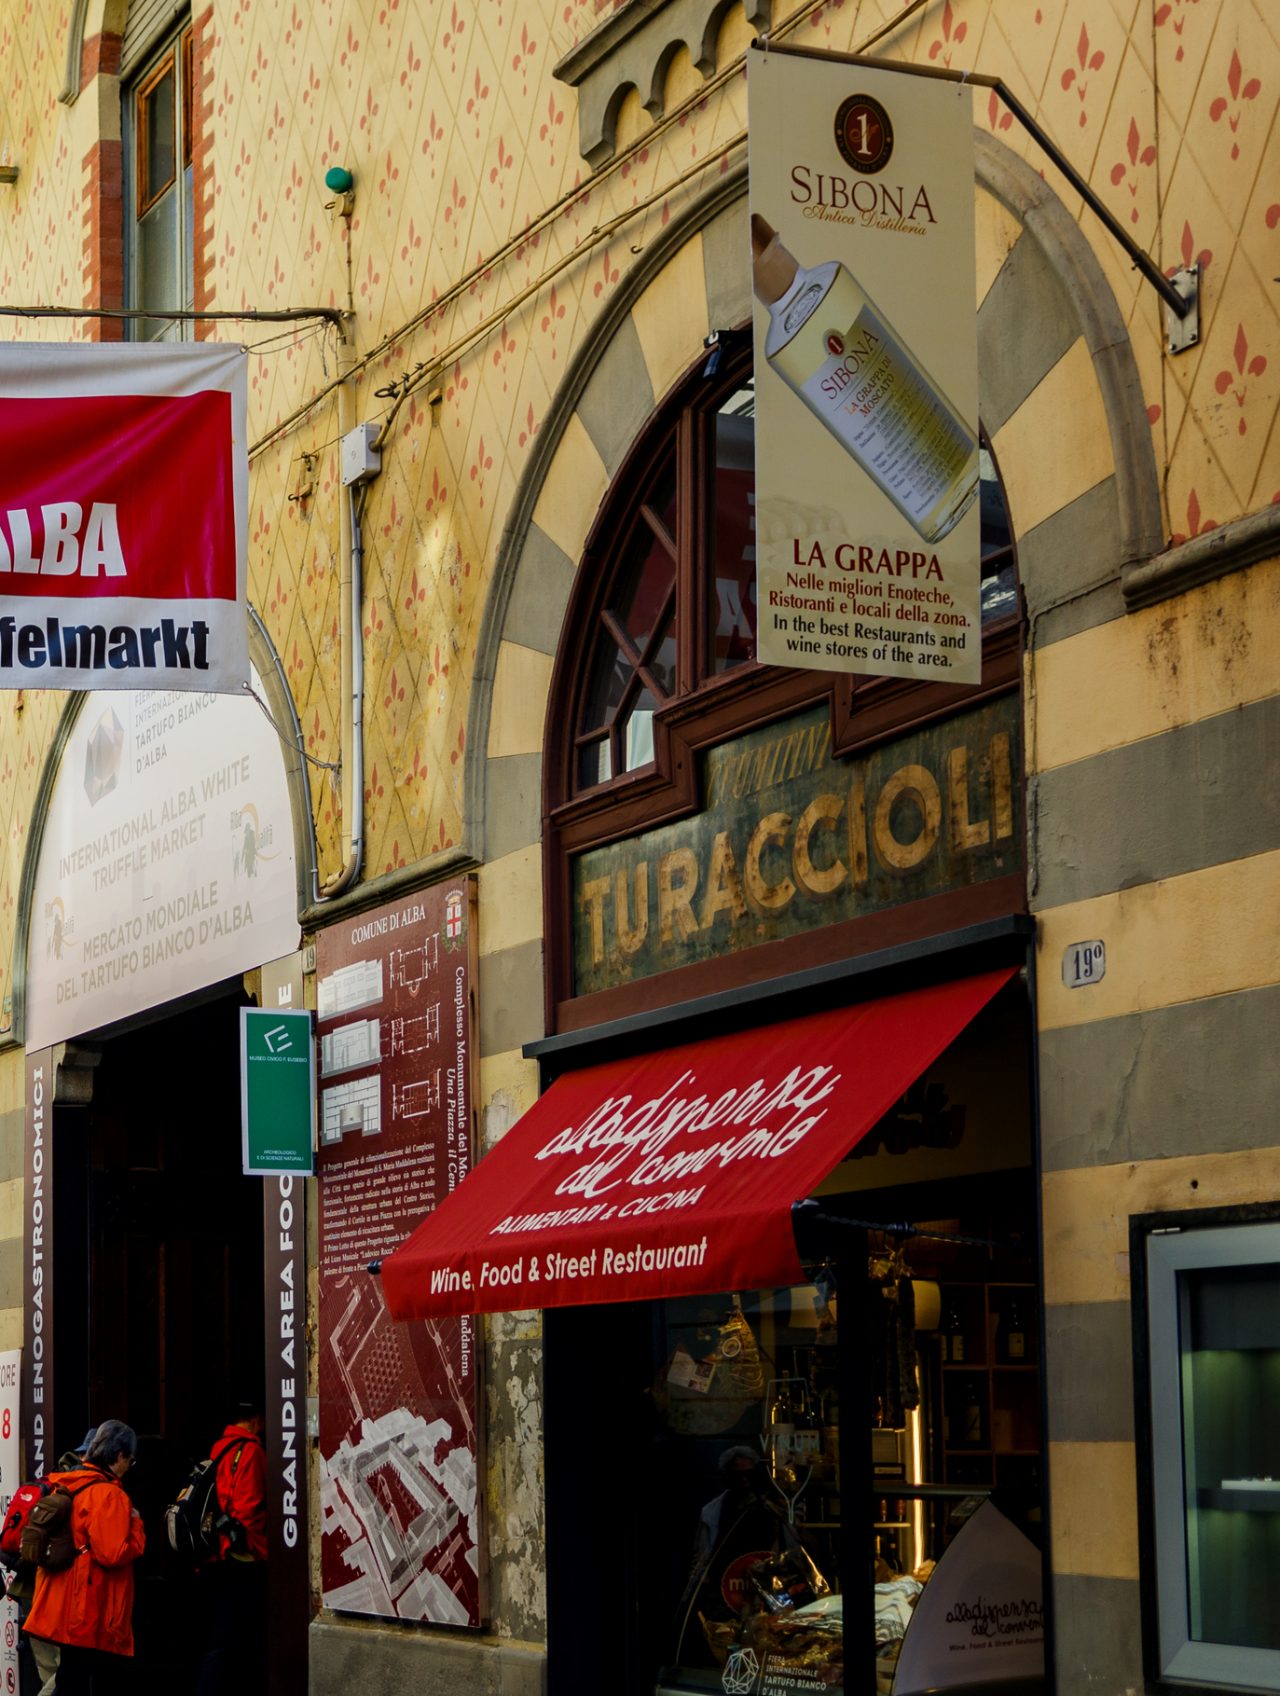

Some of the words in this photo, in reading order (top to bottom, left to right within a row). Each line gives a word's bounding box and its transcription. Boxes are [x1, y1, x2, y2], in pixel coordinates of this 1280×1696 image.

[856, 113, 872, 155] 1
[790, 165, 938, 225] SIBONA
[802, 203, 855, 226] Antica
[859, 207, 927, 236] Distilleria
[820, 330, 879, 400] SIBONA
[856, 366, 886, 403] GRAPPA
[859, 374, 895, 418] MOSCATO
[793, 538, 826, 568] LA
[834, 544, 944, 582] GRAPPA
[769, 591, 836, 613] Ristoranti
[839, 600, 849, 614] e
[852, 598, 891, 619] locali
[895, 603, 929, 624] della
[933, 612, 971, 628] zona.
[786, 572, 824, 591] Nelle
[828, 578, 883, 599] migliori
[887, 583, 955, 608] Enoteche,
[773, 614, 788, 630] In
[792, 615, 816, 634] the
[820, 618, 849, 638] best
[854, 622, 936, 646] Restaurants
[940, 632, 966, 649] and
[786, 637, 822, 654] wine
[825, 640, 869, 659] stores
[872, 642, 890, 660] of
[891, 643, 914, 663] the
[917, 651, 953, 667] area.
[136, 714, 175, 750] TARTUFO
[178, 692, 217, 725] BIANCO
[59, 806, 158, 881] INTERNATIONAL
[160, 785, 197, 824] ALBA
[201, 754, 251, 803] WHITE
[92, 848, 147, 893] TRUFFLE
[150, 813, 207, 861] MARKET
[580, 730, 1014, 966] TURACCIOLI
[82, 914, 143, 964] MERCATO
[146, 880, 219, 931] MONDIALE
[351, 920, 388, 945] COMUNE
[389, 916, 400, 932] DI
[401, 903, 426, 929] ALBA
[56, 977, 79, 1005] DEL
[81, 950, 138, 994] TARTUFO
[143, 928, 196, 977] BIANCO
[455, 966, 465, 1038] Complesso
[446, 1068, 455, 1096] Una
[457, 1040, 465, 1128] Monumentale
[446, 1099, 456, 1145] Piazza,
[279, 1176, 294, 1252] FOO
[489, 1202, 600, 1236] ALIMENTARI
[616, 1184, 707, 1220] CUCINA
[430, 1260, 475, 1295] Wine,
[479, 1256, 523, 1288] Food
[528, 1256, 540, 1281] &
[545, 1247, 597, 1281] Street
[601, 1236, 709, 1273] Restaurant
[280, 1259, 295, 1370] AREA
[282, 1378, 298, 1548] GRANDE
[759, 1433, 820, 1454] VINUM
[765, 1675, 795, 1687] TARTUFO
[797, 1679, 826, 1691] BIANCO
[766, 1665, 818, 1678] INTERNAZIONALE
[768, 1655, 785, 1666] FIERA
